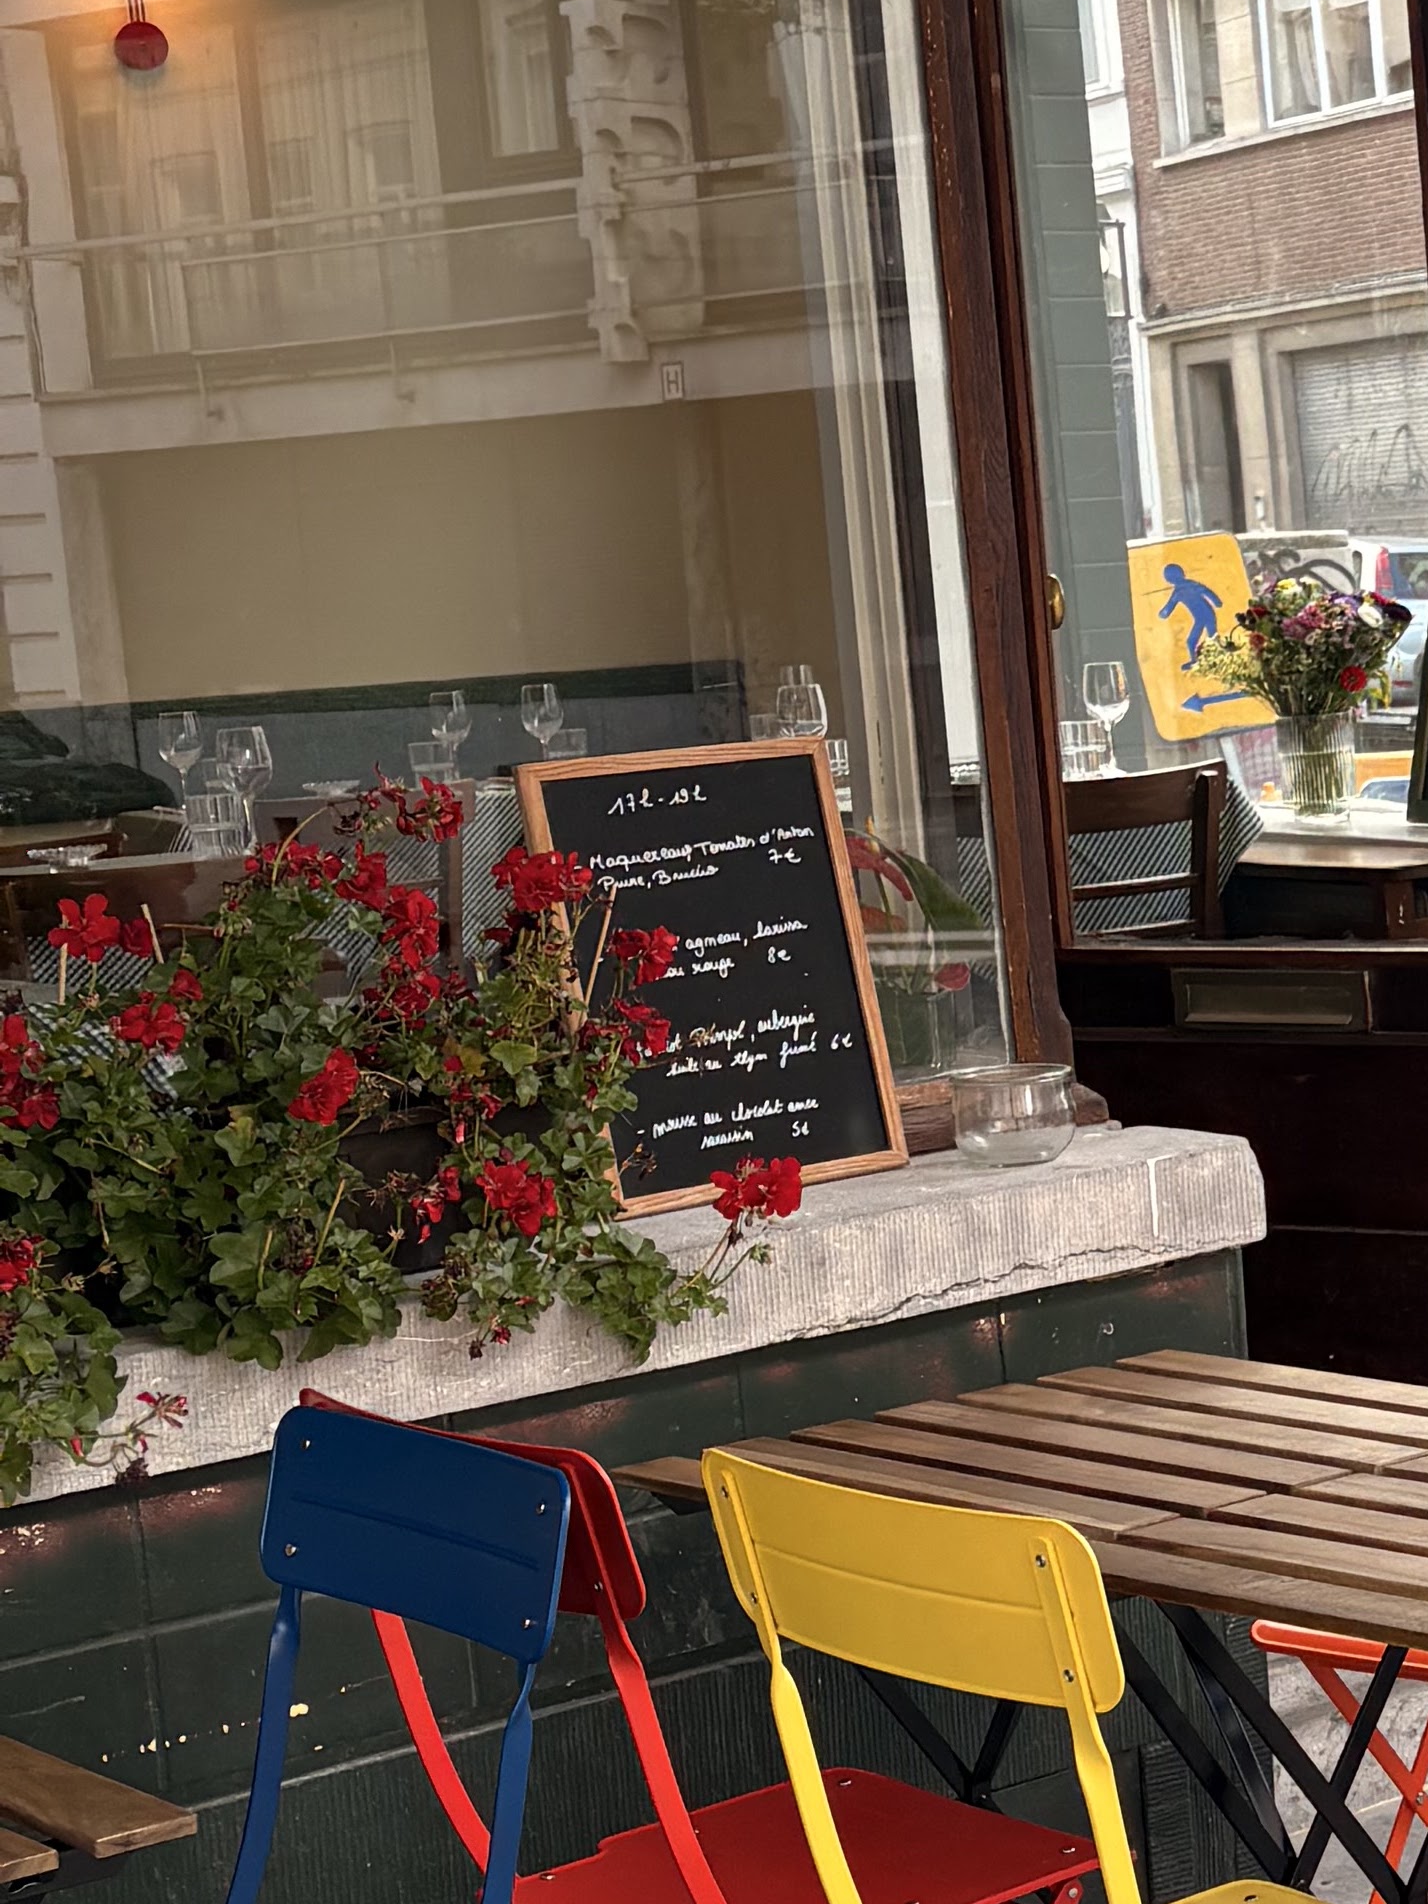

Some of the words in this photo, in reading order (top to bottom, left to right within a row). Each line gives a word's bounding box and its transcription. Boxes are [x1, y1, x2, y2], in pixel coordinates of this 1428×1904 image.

[608, 788, 654, 815] 17h
[669, 785, 707, 806] 19h
[767, 848, 802, 864] 7€
[691, 957, 735, 980] rouge
[703, 1109, 723, 1124] au
